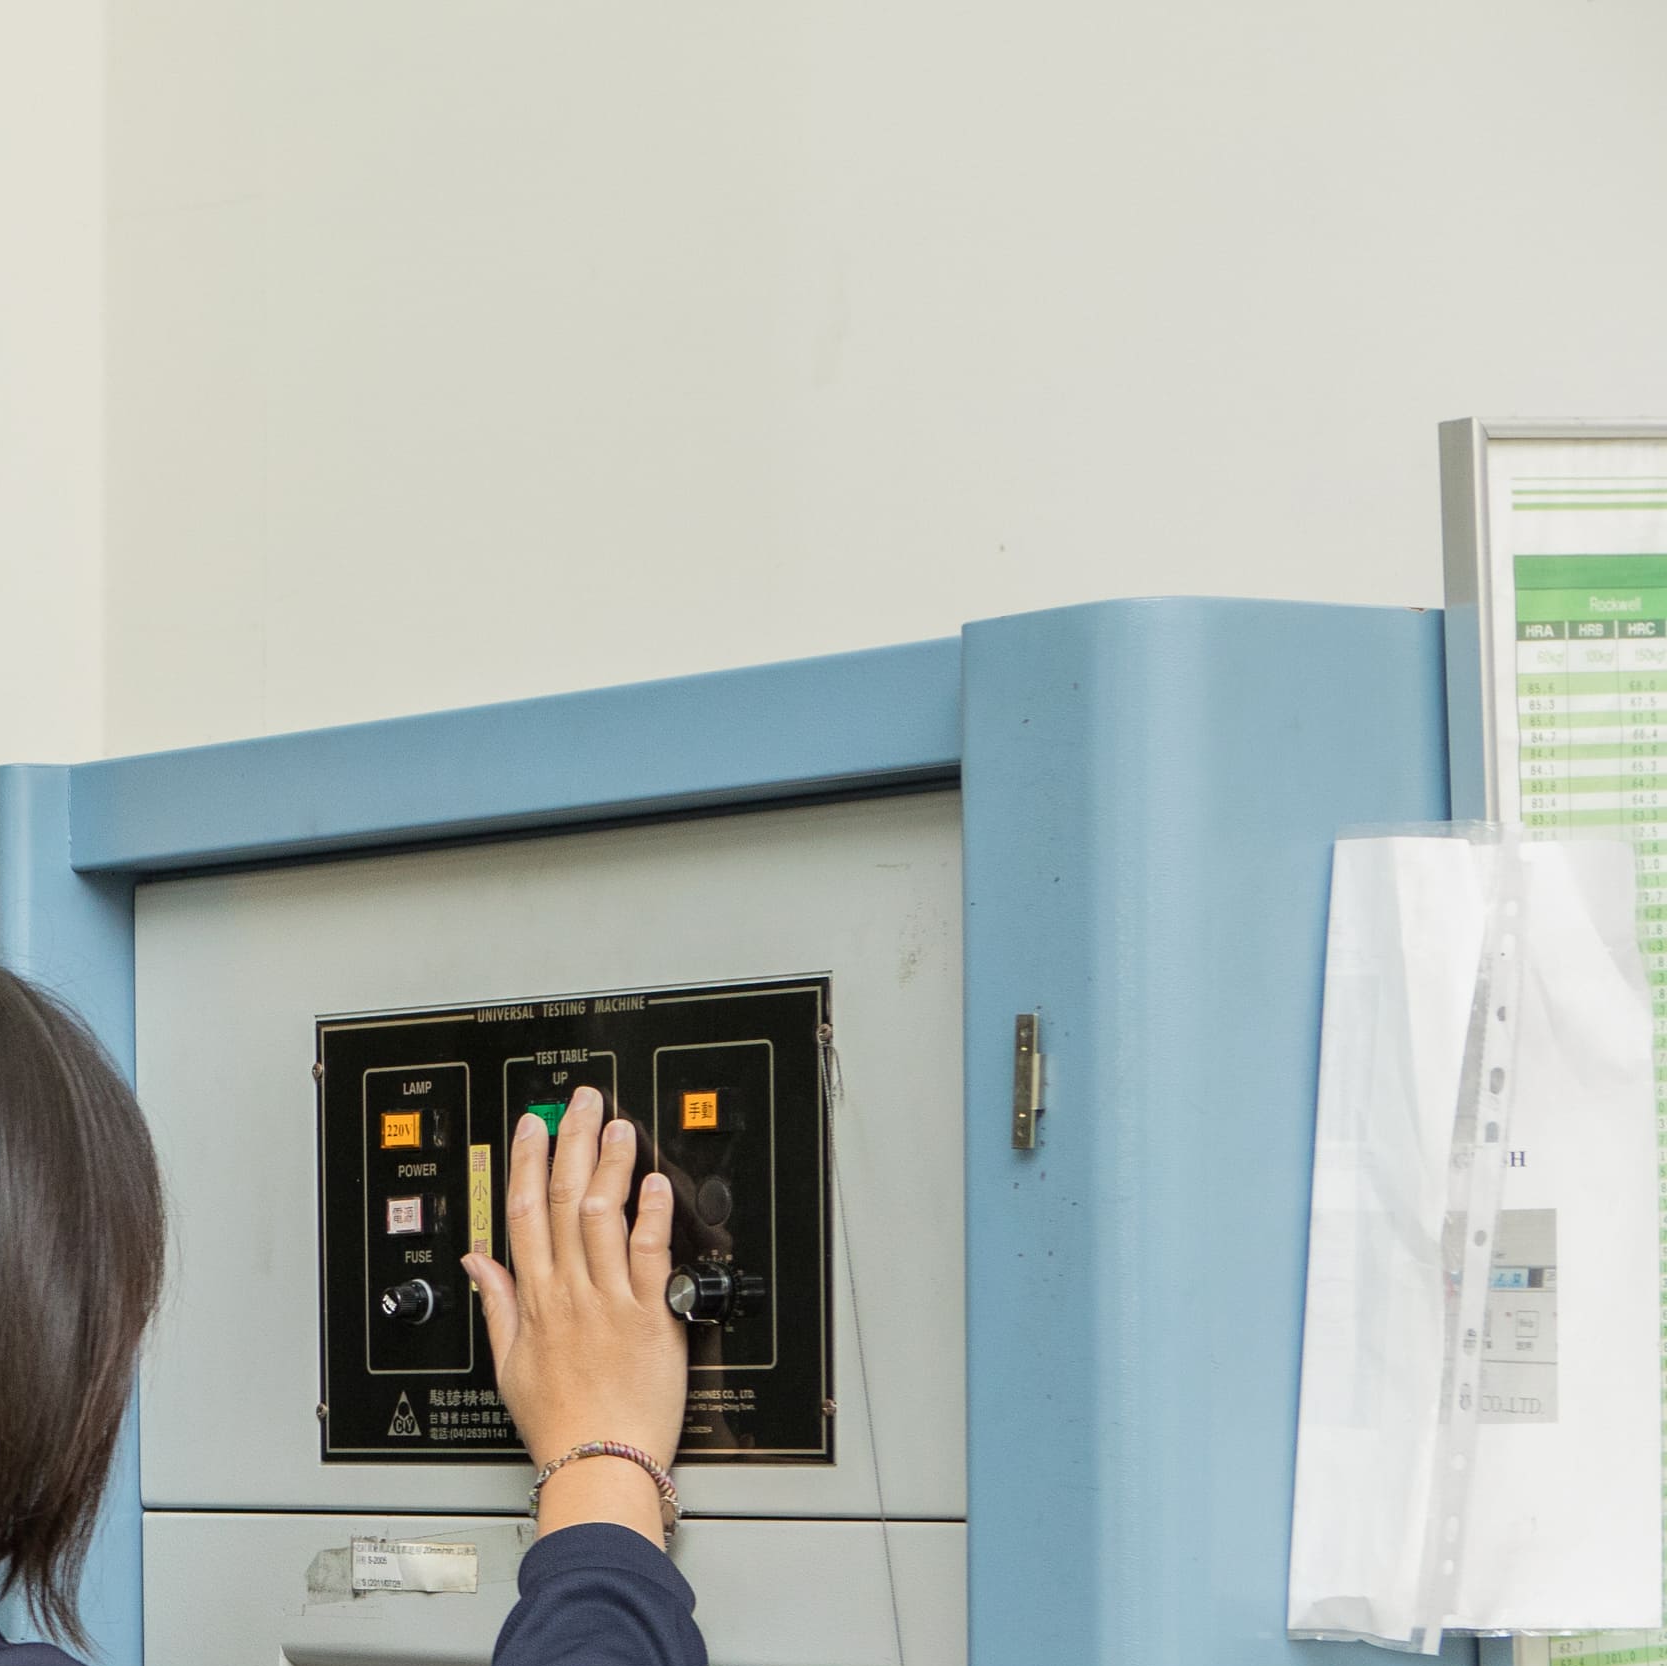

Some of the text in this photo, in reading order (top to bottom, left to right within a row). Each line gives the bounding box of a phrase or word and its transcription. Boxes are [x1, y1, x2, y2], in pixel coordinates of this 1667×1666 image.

[1525, 622, 1656, 638] HRA HRB HRC
[477, 996, 646, 1023] UNIVERSAL TESTING MACHINE
[536, 1049, 588, 1065] TEST TABLE
[553, 1072, 568, 1086] UP
[403, 1081, 433, 1095] LAMP
[386, 1123, 413, 1137] 220V
[398, 1163, 437, 1178] POWER
[392, 1206, 414, 1224] 電源
[405, 1250, 433, 1264] FUSE
[1605, 1650, 1636, 1665] 101.0
